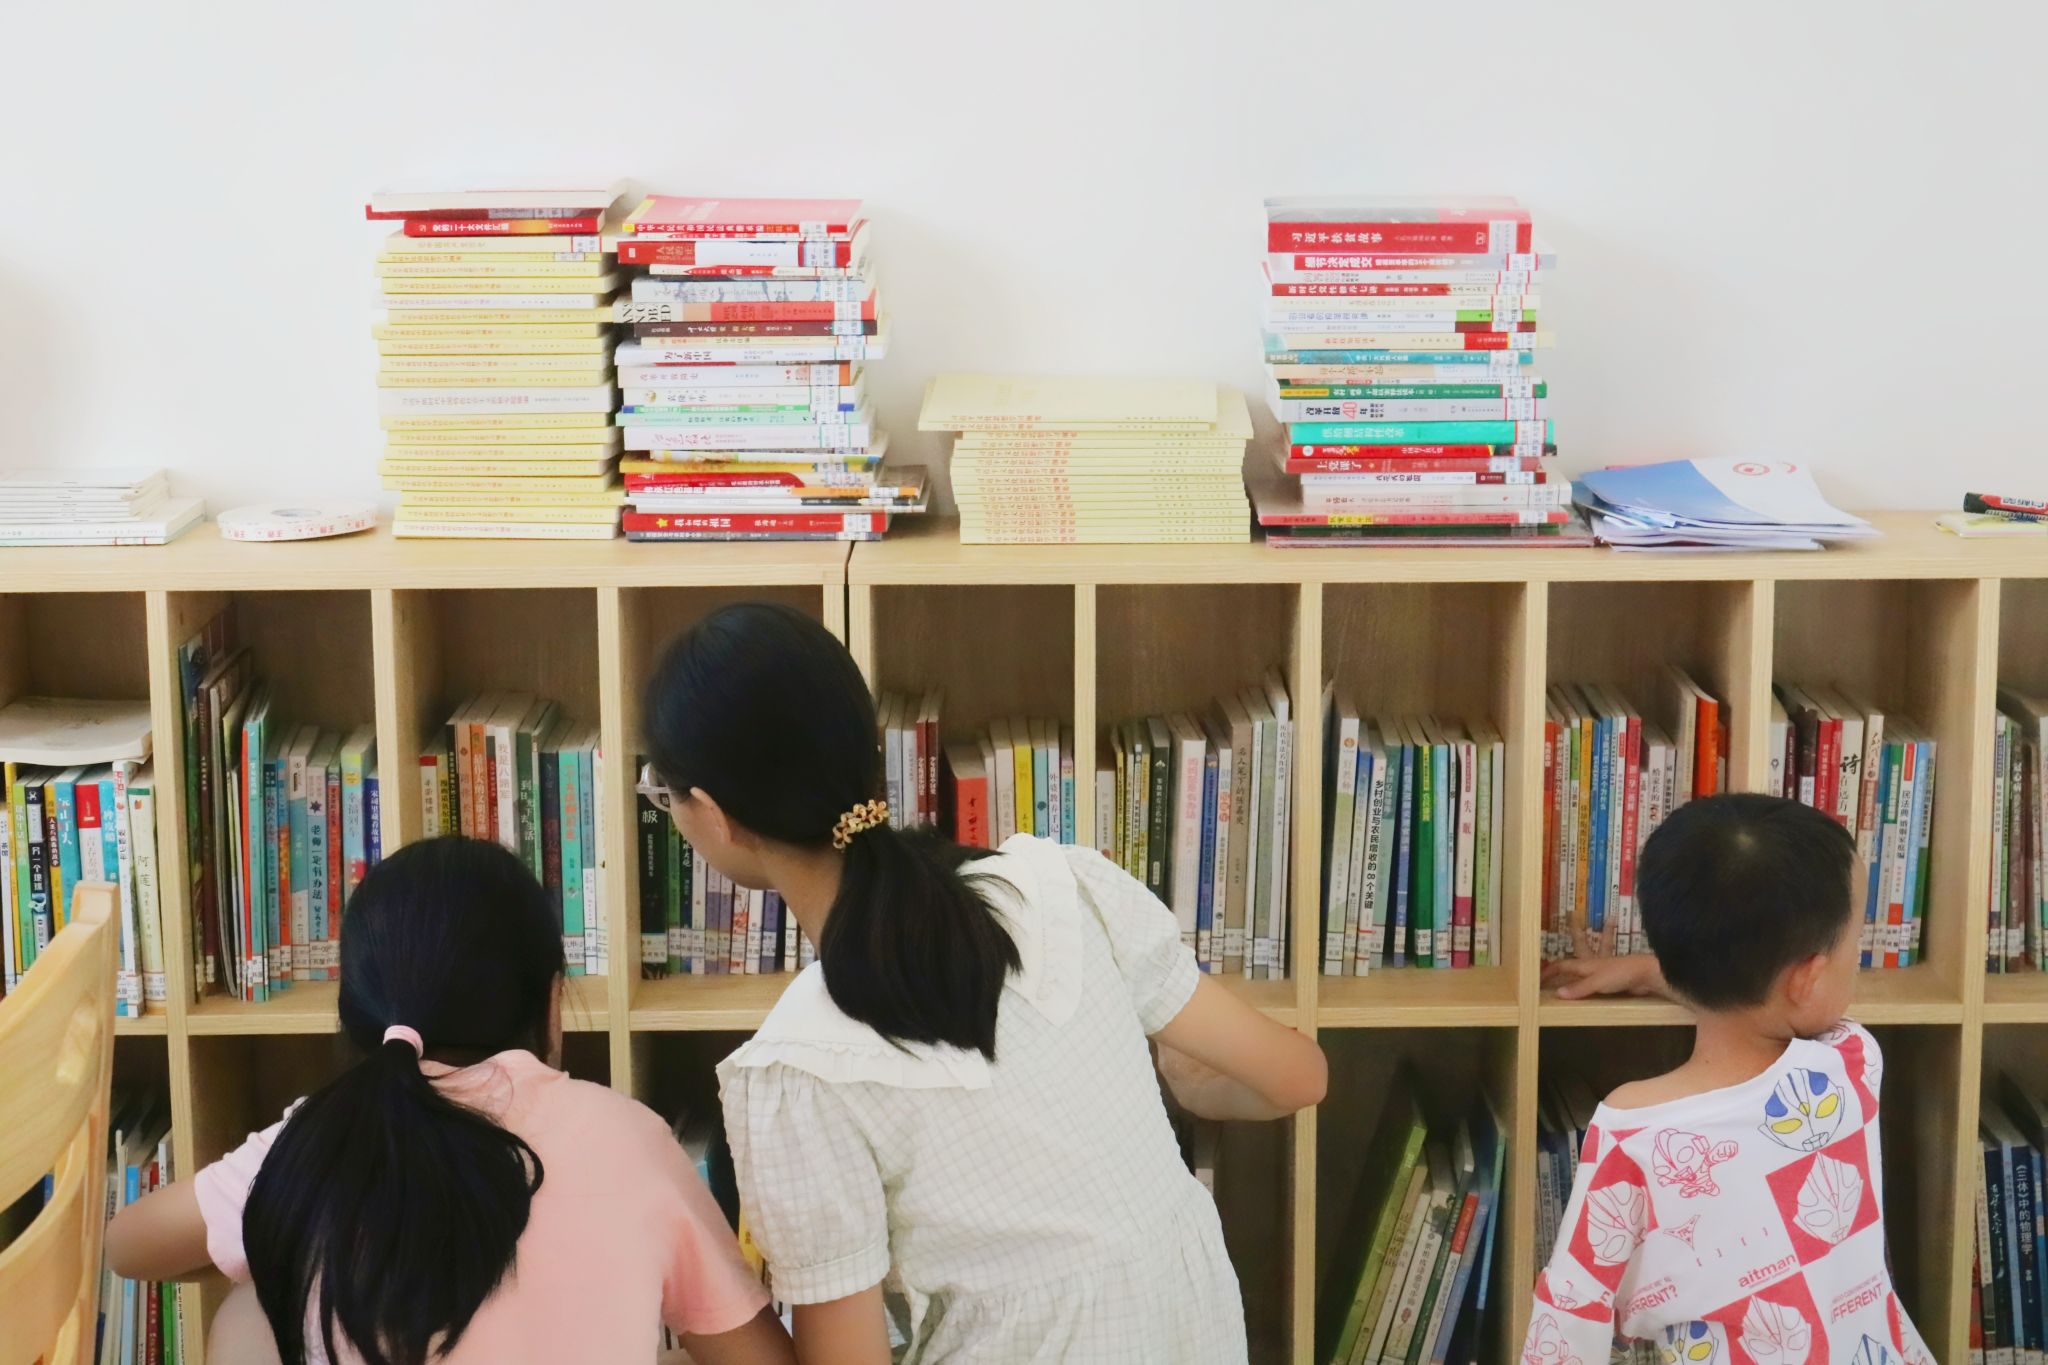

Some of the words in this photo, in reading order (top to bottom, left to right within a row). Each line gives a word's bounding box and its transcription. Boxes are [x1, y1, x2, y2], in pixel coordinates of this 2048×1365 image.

[1291, 232, 1383, 243] 习近平扶贫故事
[664, 350, 712, 361] 为了新中国
[674, 518, 732, 528] 我和我的祖国
[642, 810, 658, 824] 极
[1462, 798, 1472, 836] 失眠
[1900, 789, 1912, 817] 民法典
[1363, 780, 1384, 910] 乡村创业与农民增收的8个关键
[2015, 1163, 2033, 1255] 《三体》中的物理学
[1738, 1254, 1797, 1289] aitman
